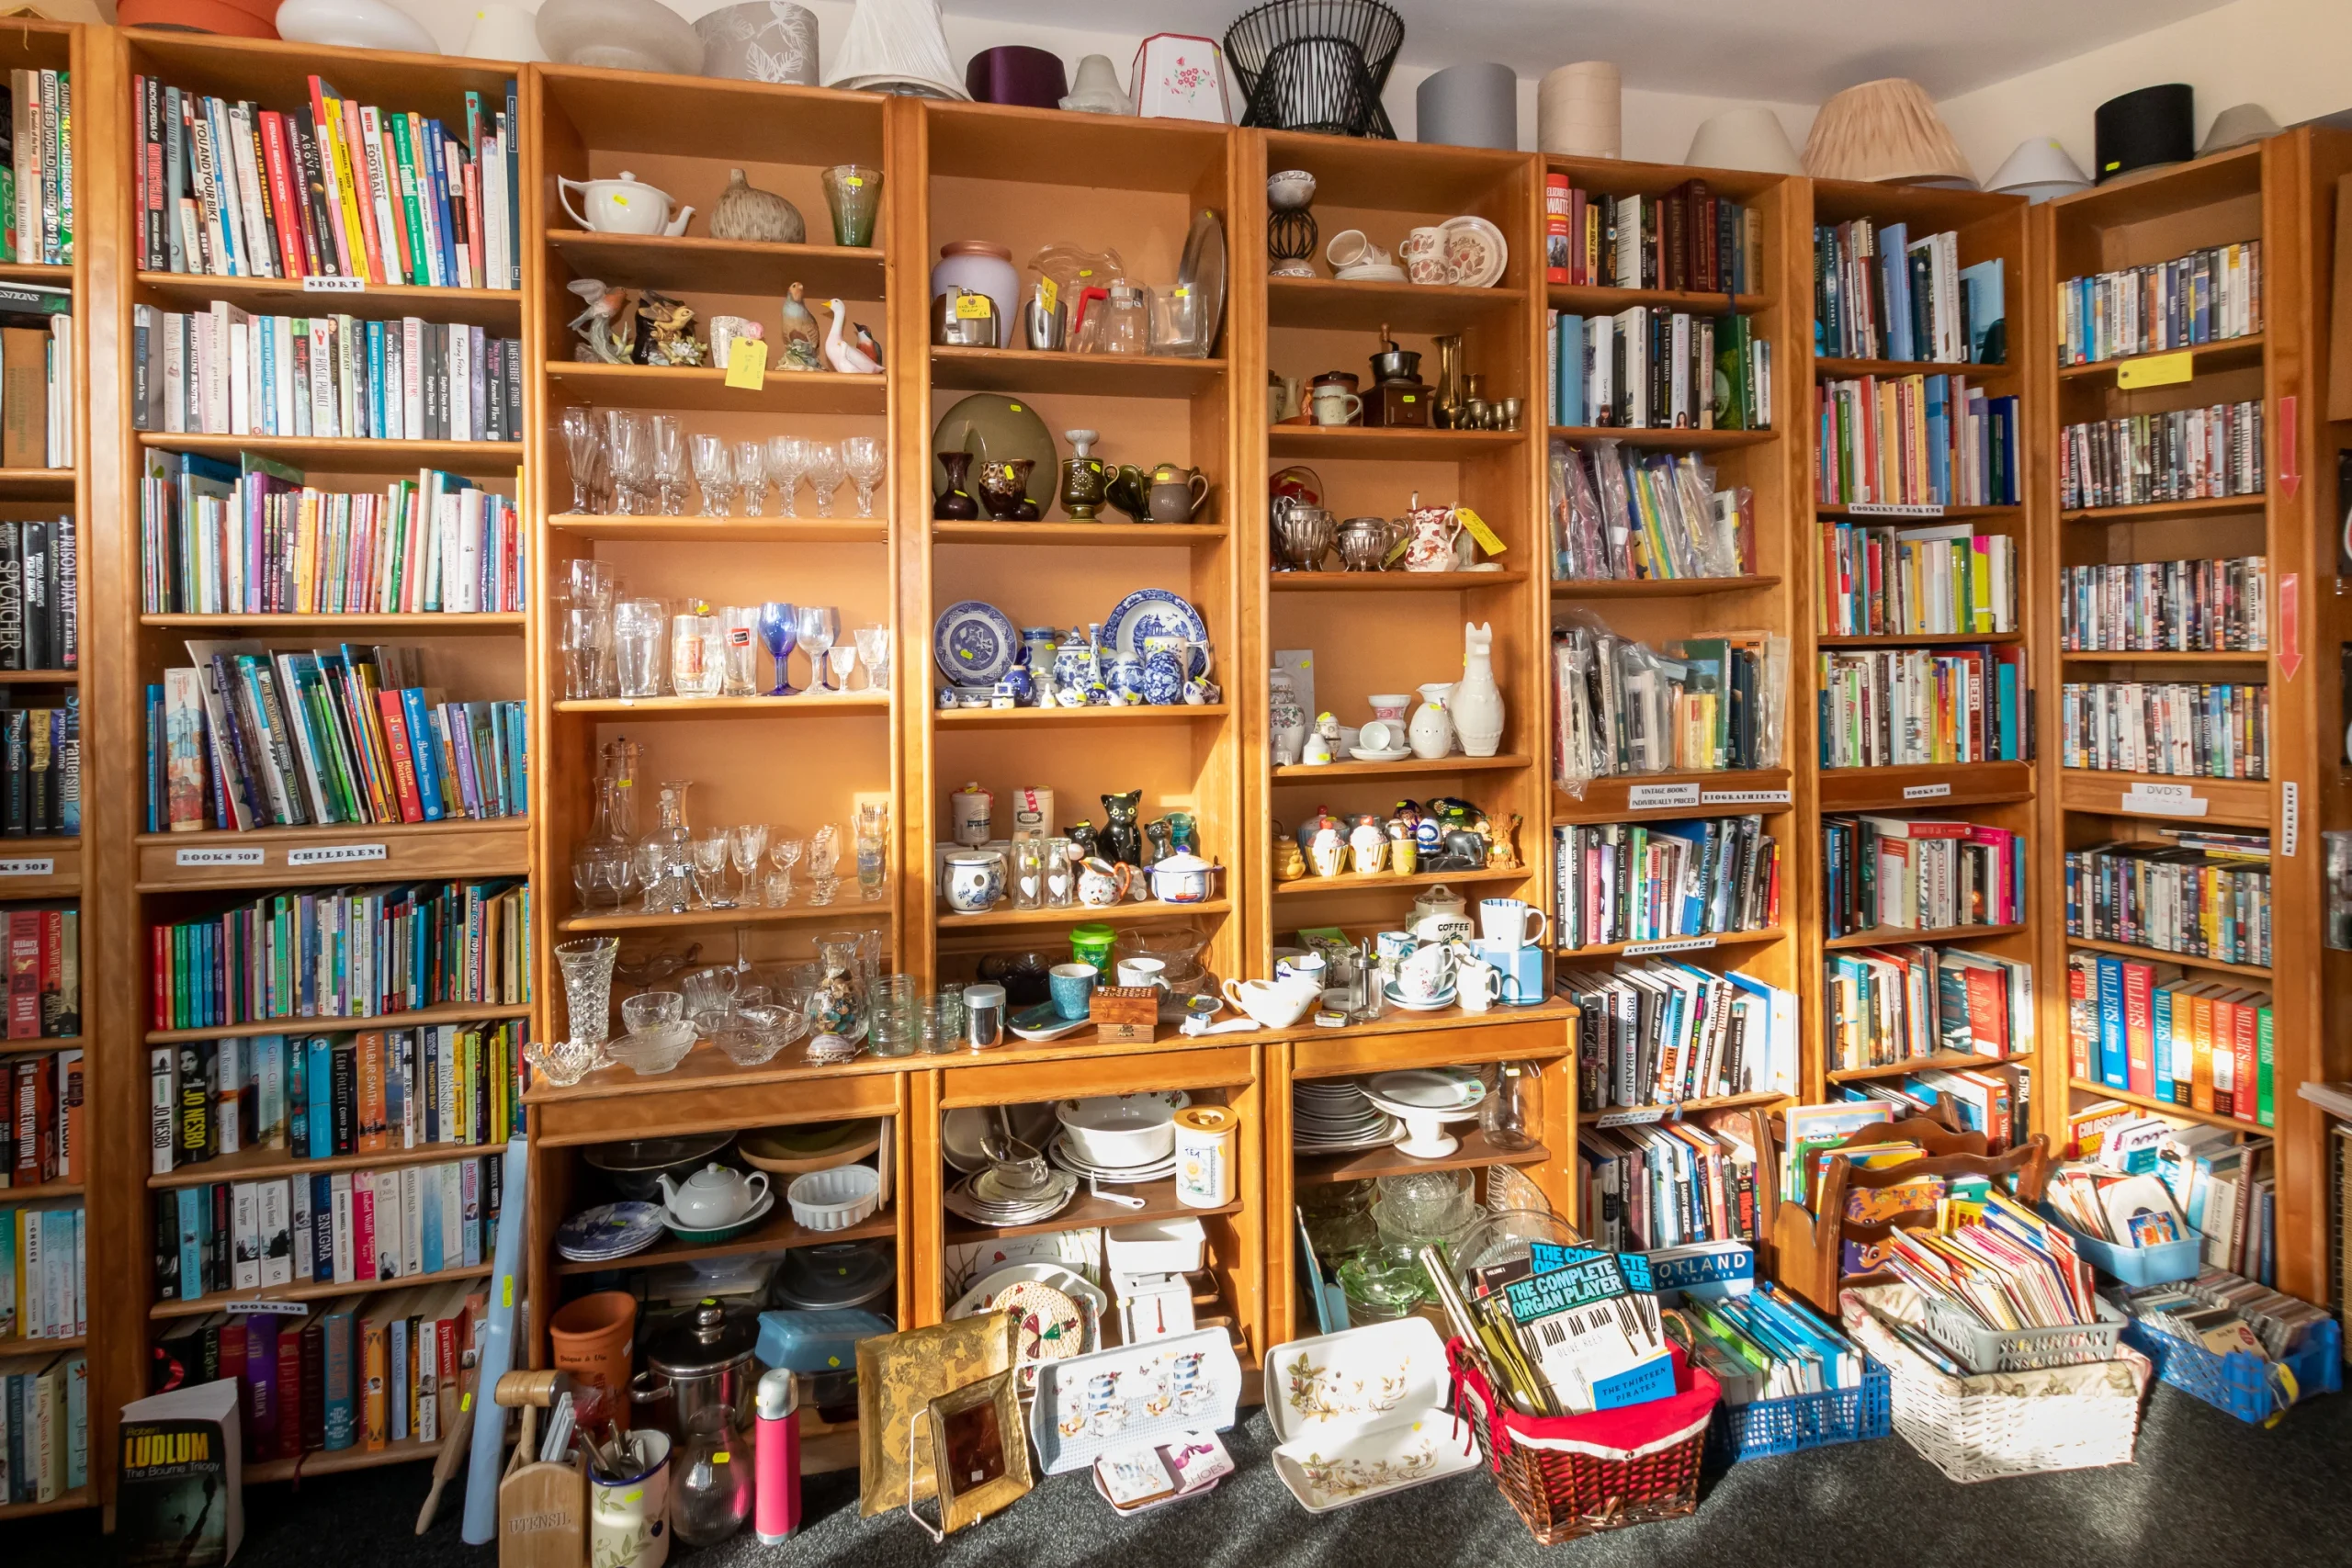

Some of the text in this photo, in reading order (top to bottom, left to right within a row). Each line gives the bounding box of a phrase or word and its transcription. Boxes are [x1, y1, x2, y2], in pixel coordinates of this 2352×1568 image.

[148, 81, 157, 131] ENCYCLOPEDIA
[43, 73, 59, 245] GUINNESS WORLD RECORDS 2012
[62, 130, 72, 166] WORLD
[300, 133, 316, 176] ABOVE
[340, 143, 350, 171] ANNUAL
[196, 123, 219, 223] YOU AND YOUR BIKE
[368, 143, 383, 202] FOOTBALL
[1547, 198, 1568, 214] WAITE
[343, 344, 351, 371] OUTCAST
[60, 536, 75, 575] PRISON
[0, 560, 22, 649] SPYCATCHER
[61, 580, 76, 613] DIARY
[1970, 678, 1979, 711] BEER
[2153, 702, 2161, 733] KINSEY
[12, 714, 20, 772] Perfect Silence
[390, 716, 405, 755] Junior
[66, 739, 81, 802] Patterson
[396, 761, 408, 798] Dictionary
[405, 761, 413, 786] Picture
[1632, 798, 1672, 807] INDIVIDUALLY
[2146, 785, 2183, 796] DVD'S
[2286, 785, 2294, 852] REFERENCE
[293, 848, 384, 861] CHILDRENS
[1722, 846, 1730, 886] OSBOURNE
[1437, 922, 1470, 932] COFFEE
[1626, 940, 1713, 953] AUTOBIOGRAPHY
[292, 1052, 300, 1069] Trophy
[1625, 997, 1635, 1093] RUSSELL BRAND
[335, 1054, 347, 1070] KEN
[367, 1035, 377, 1107] WILBUR SMITH
[184, 1089, 205, 1106] JO
[336, 1073, 347, 1105] FOLLETT
[440, 1065, 449, 1115] BEGINNING
[2018, 1076, 2030, 1103] ISTRIA
[154, 1105, 170, 1116] JO
[1184, 1148, 1200, 1158] TEA
[1699, 1163, 1707, 1186] 1000
[363, 1191, 371, 1213] Isabel
[407, 1170, 416, 1213] MICHAEL PALIN
[318, 1213, 332, 1261] ENIGMA
[1506, 1280, 1537, 1302] THE
[1536, 1259, 1617, 1294] COMPLETE
[1652, 1253, 1747, 1279] OTLAND
[1512, 1290, 1564, 1318] ORGAN
[1562, 1274, 1624, 1305] PLAYER
[442, 1342, 452, 1373] andrews
[1602, 1366, 1667, 1397] THE THIRTEEN
[1616, 1382, 1657, 1403] PIRATES
[254, 1381, 266, 1418] WARLOCK
[125, 1433, 209, 1469] LUDLUM
[126, 1462, 220, 1478] The Bourne Trilogy
[509, 1511, 571, 1534] UTENSIL
